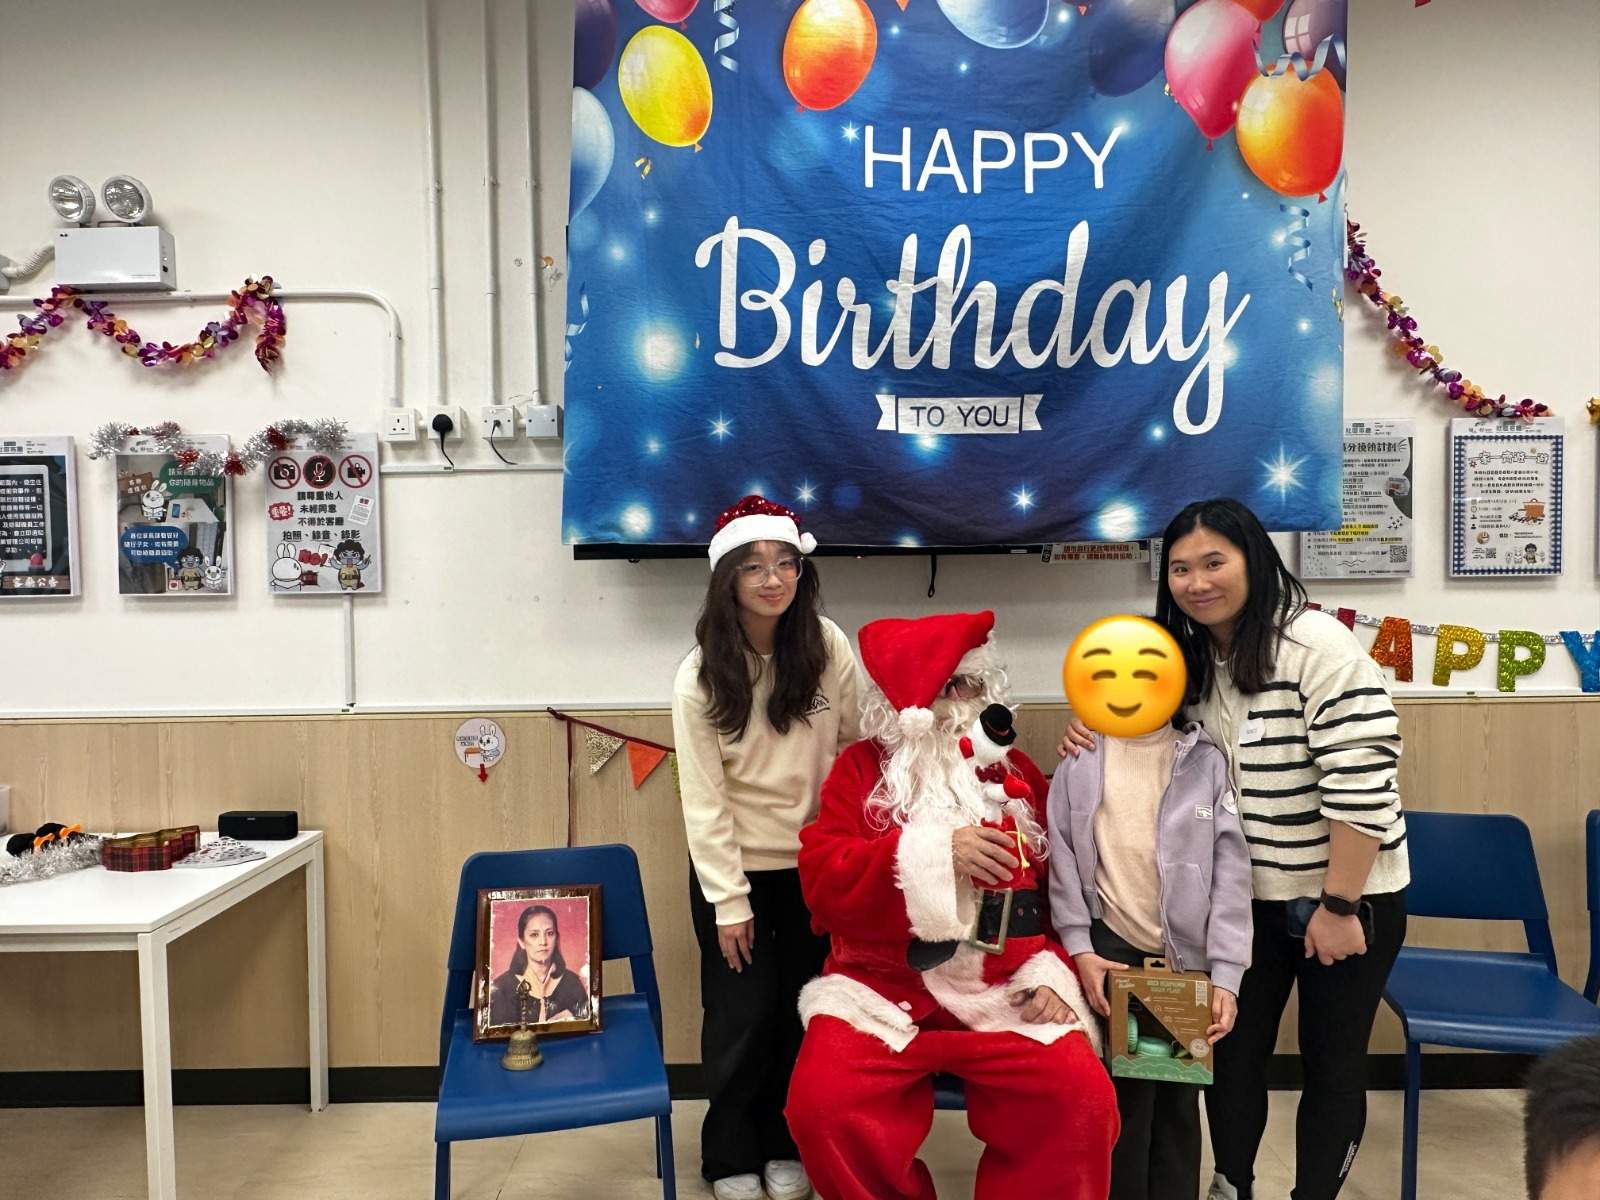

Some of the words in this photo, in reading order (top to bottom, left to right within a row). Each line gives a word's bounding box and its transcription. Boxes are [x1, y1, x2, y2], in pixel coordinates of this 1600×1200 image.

[864, 124, 1122, 194] HAPPY
[694, 215, 1252, 436] Birthday
[909, 405, 944, 428] TO
[956, 404, 1010, 428] YOU
[297, 491, 343, 501] 請尊重他人
[300, 504, 337, 514] 未經同意
[298, 517, 344, 526] 不得於客廳
[282, 530, 360, 541] 拍照、錄音、錄影
[1337, 606, 1600, 692] APPY
